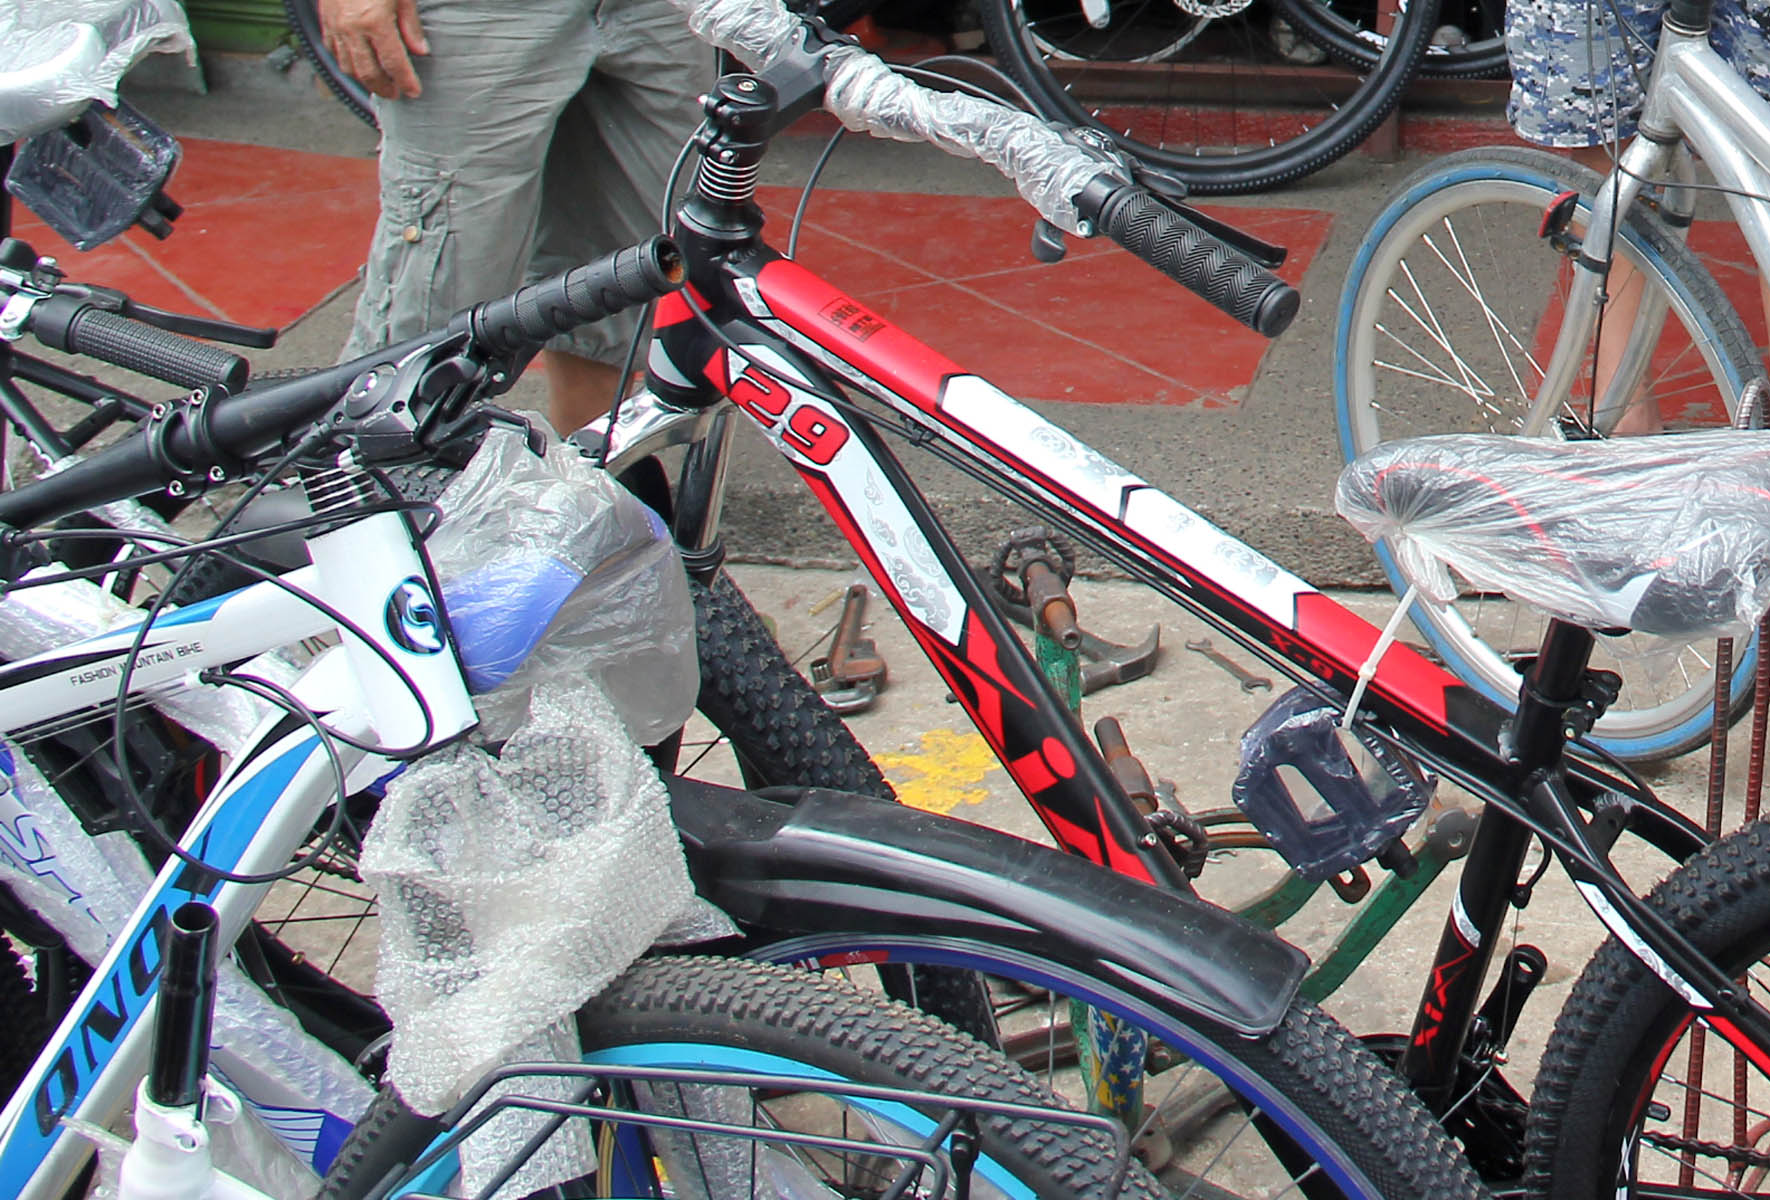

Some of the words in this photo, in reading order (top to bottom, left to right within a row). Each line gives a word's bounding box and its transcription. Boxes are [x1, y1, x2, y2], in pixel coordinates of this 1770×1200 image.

[728, 365, 850, 467] 29
[70, 665, 118, 687] FASHION
[119, 649, 175, 675] UNTAIN
[176, 641, 204, 657] BIKE
[1269, 631, 1335, 681] X-9
